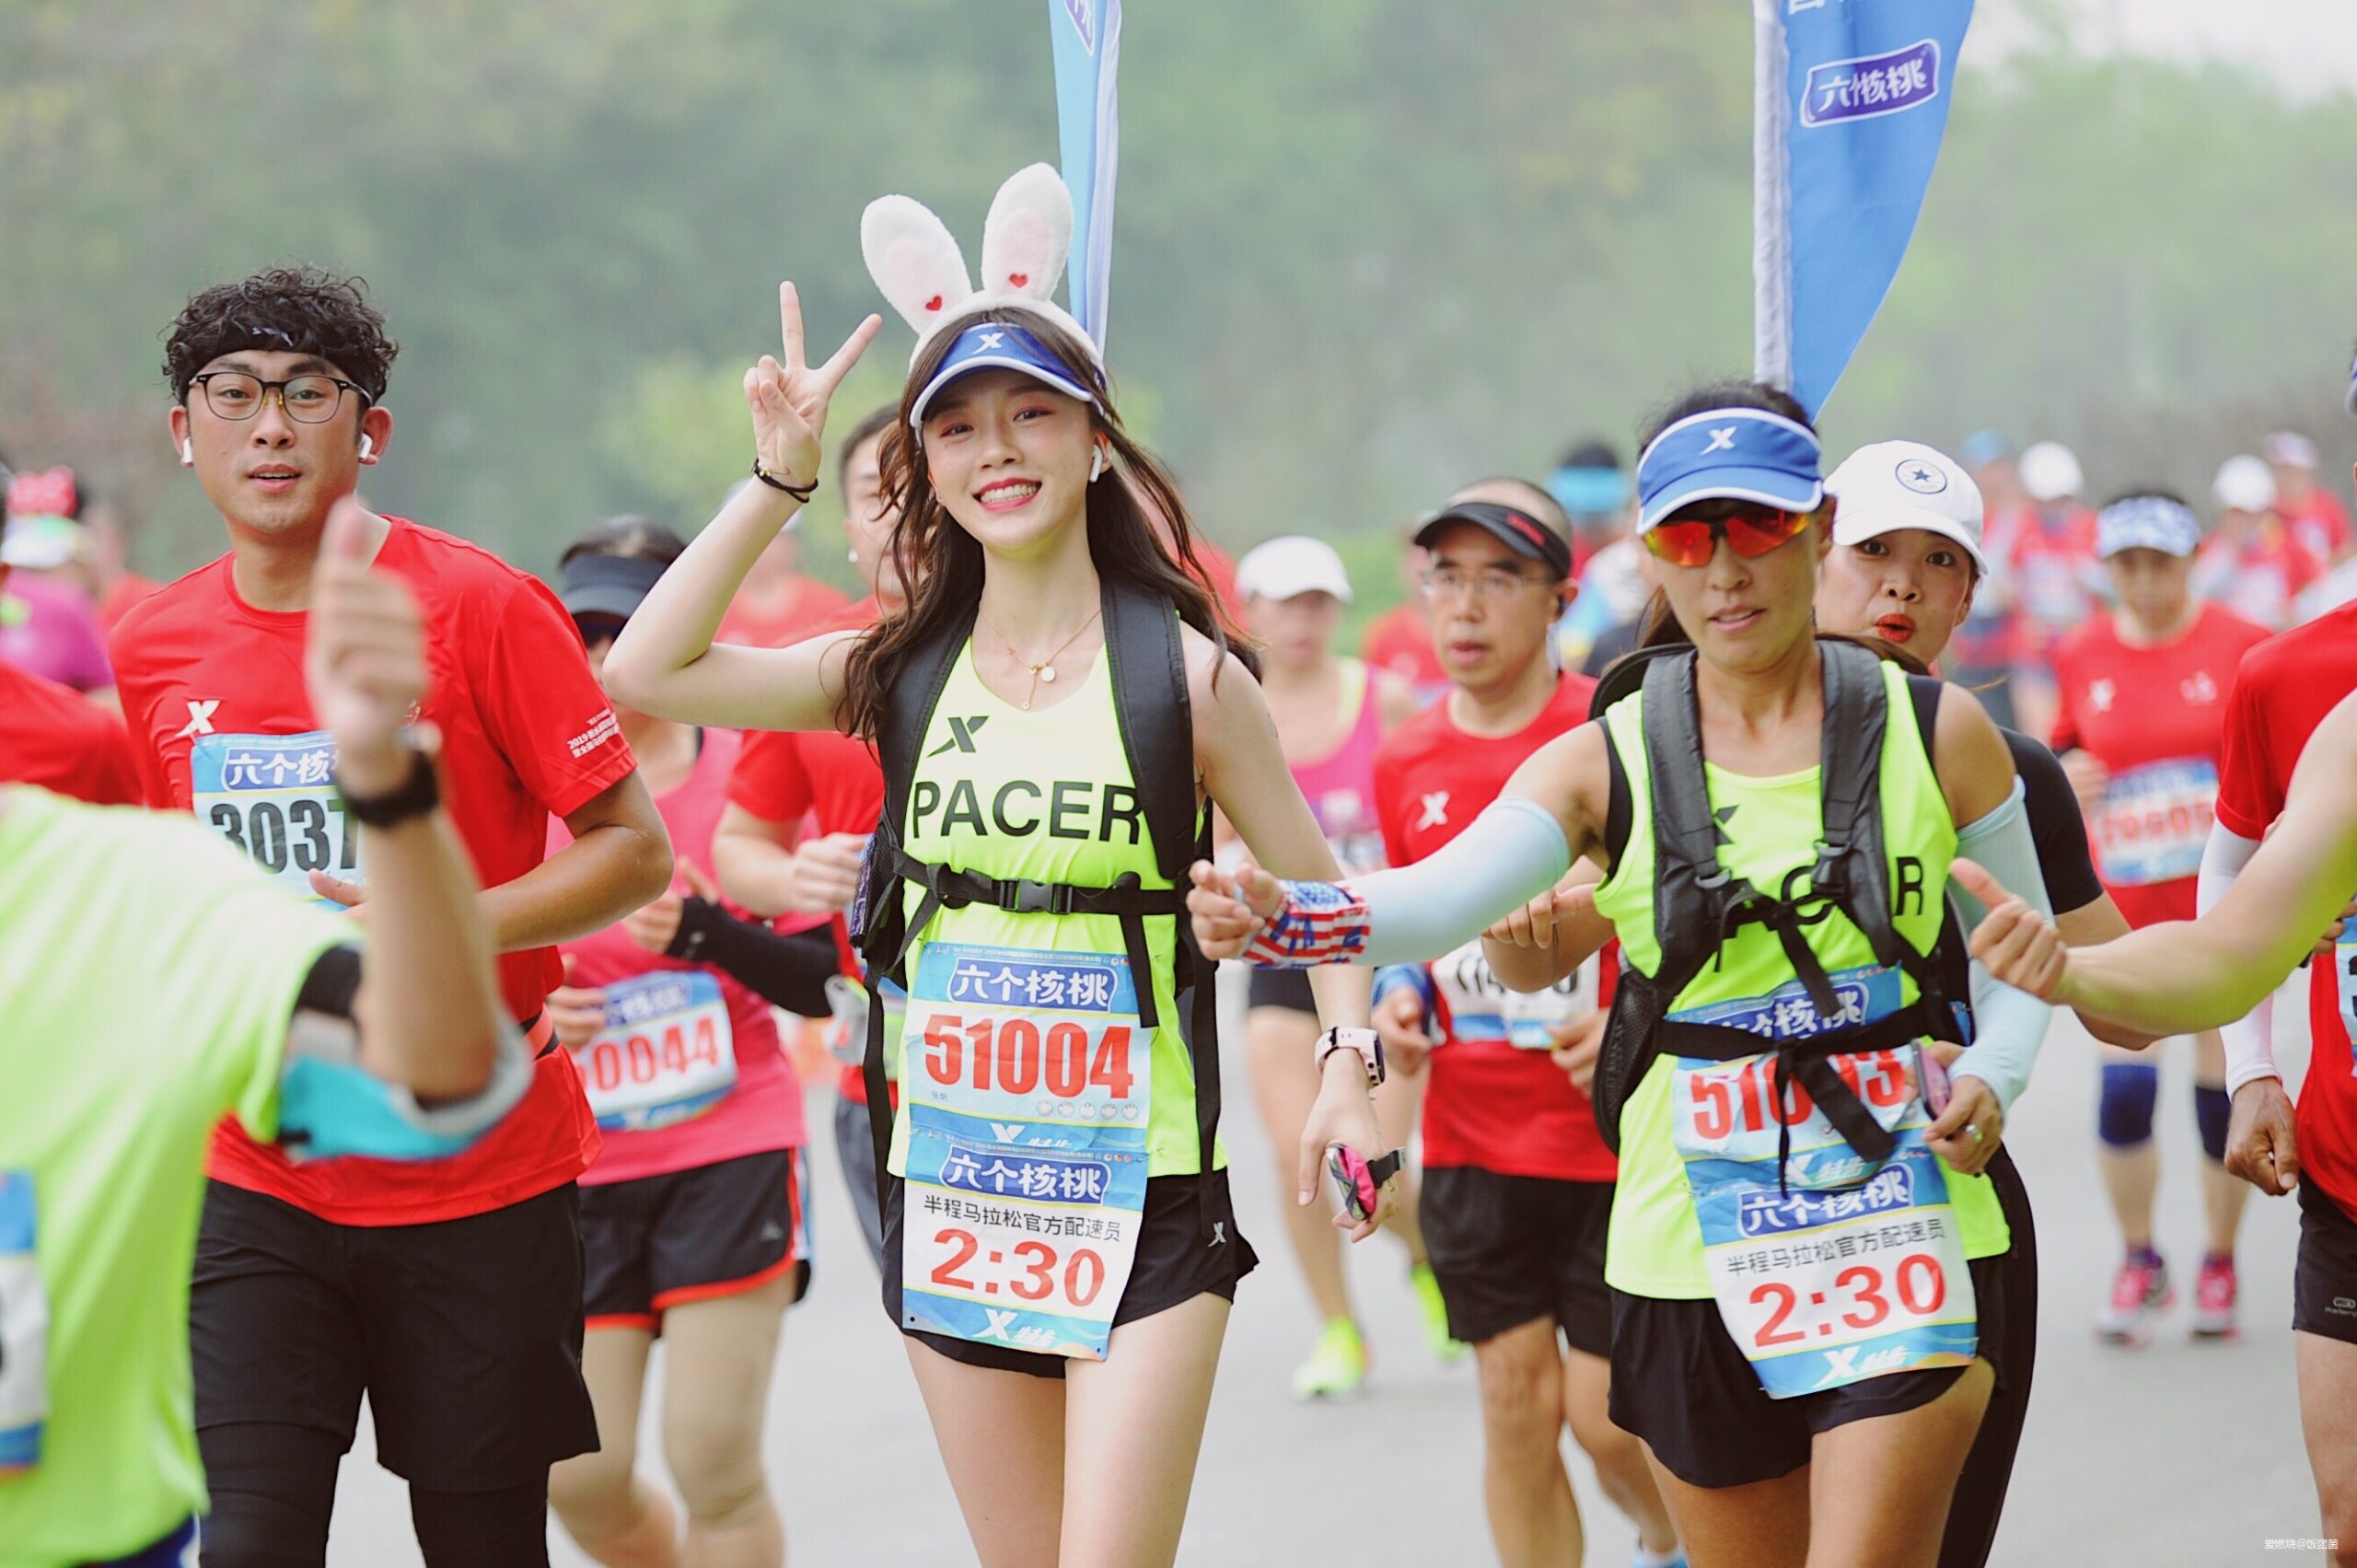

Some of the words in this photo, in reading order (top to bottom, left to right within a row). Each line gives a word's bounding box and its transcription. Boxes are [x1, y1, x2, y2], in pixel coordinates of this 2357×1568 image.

[227, 748, 341, 786] 六个核
[912, 779, 1144, 845] PACER
[955, 964, 1109, 1007] 六个核桃
[563, 1016, 718, 1093] 0044
[923, 1014, 1134, 1099] 51004
[946, 1154, 1103, 1201] 六个核桃
[1742, 1170, 1910, 1232] 六个核桃
[923, 1194, 1120, 1242] 半程马拉松官方配速员
[1727, 1218, 1947, 1277] 半程马拉松官方配速员
[931, 1228, 1106, 1307] 2:30
[1749, 1253, 1946, 1347] 2:30
